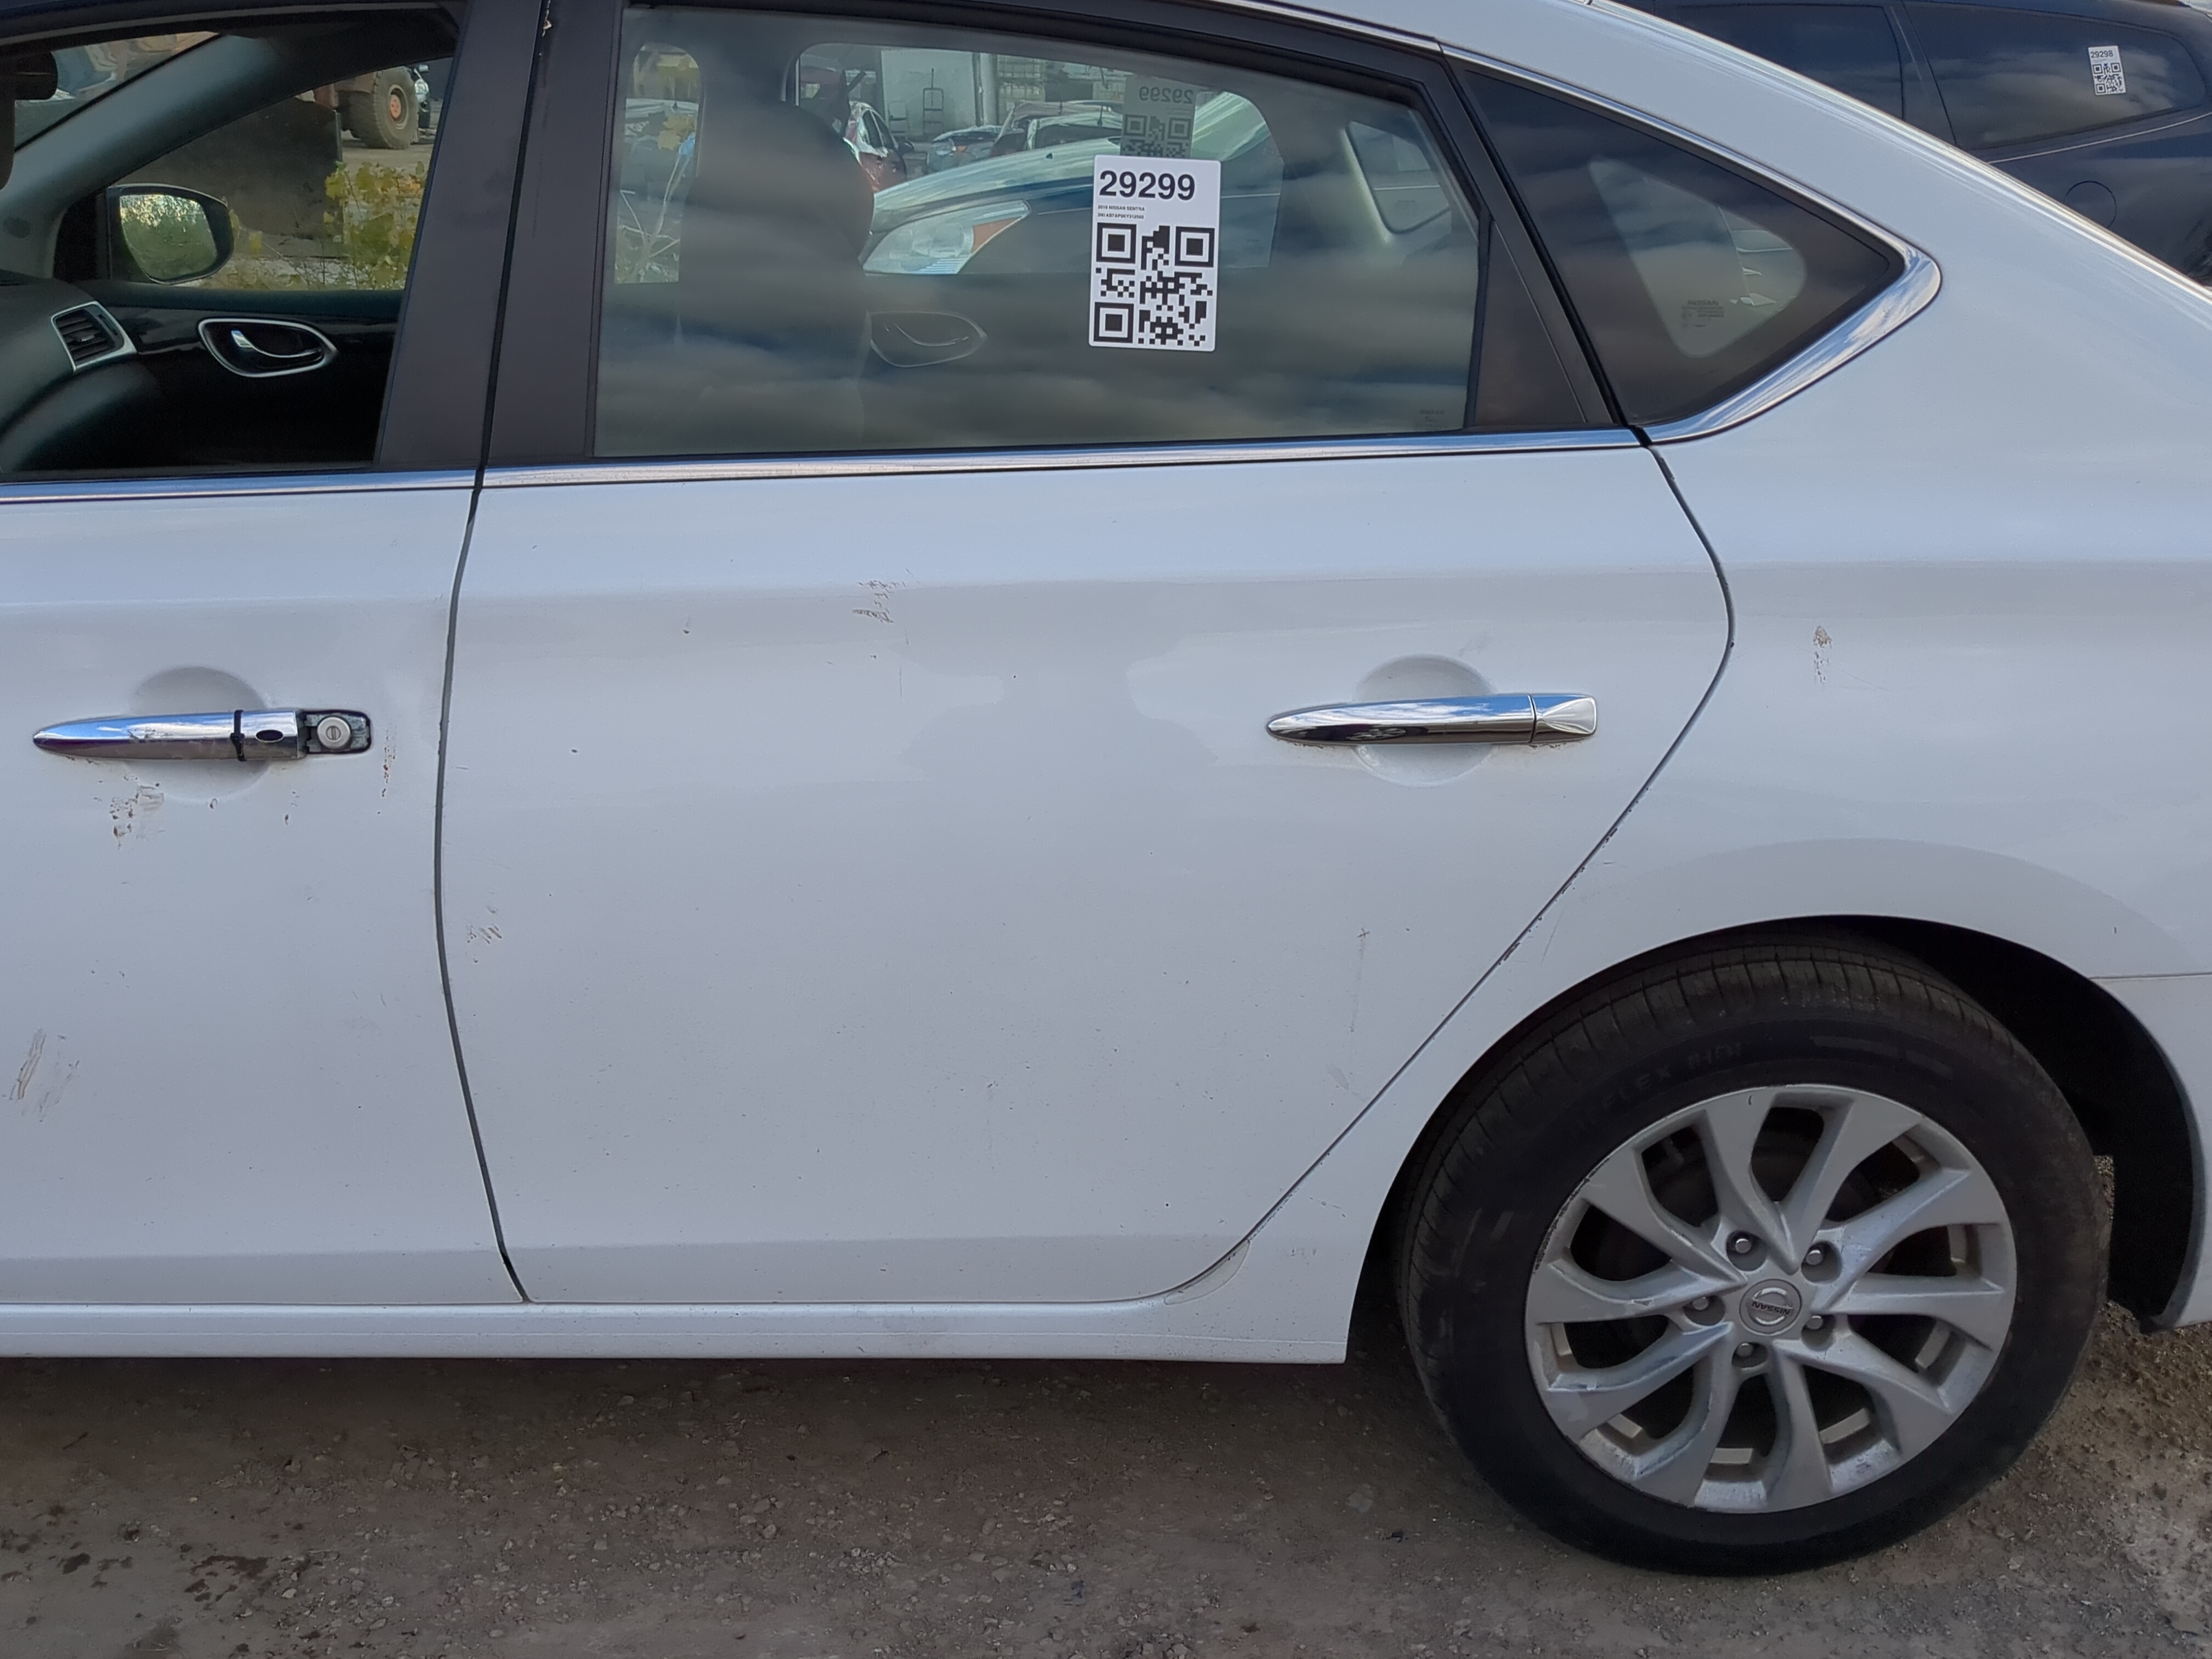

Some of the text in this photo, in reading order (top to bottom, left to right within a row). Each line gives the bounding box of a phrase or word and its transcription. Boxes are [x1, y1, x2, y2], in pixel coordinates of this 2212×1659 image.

[2090, 50, 2114, 58] 29298
[1099, 170, 1195, 201] 29299
[1752, 1301, 1791, 1315] NISSAN
